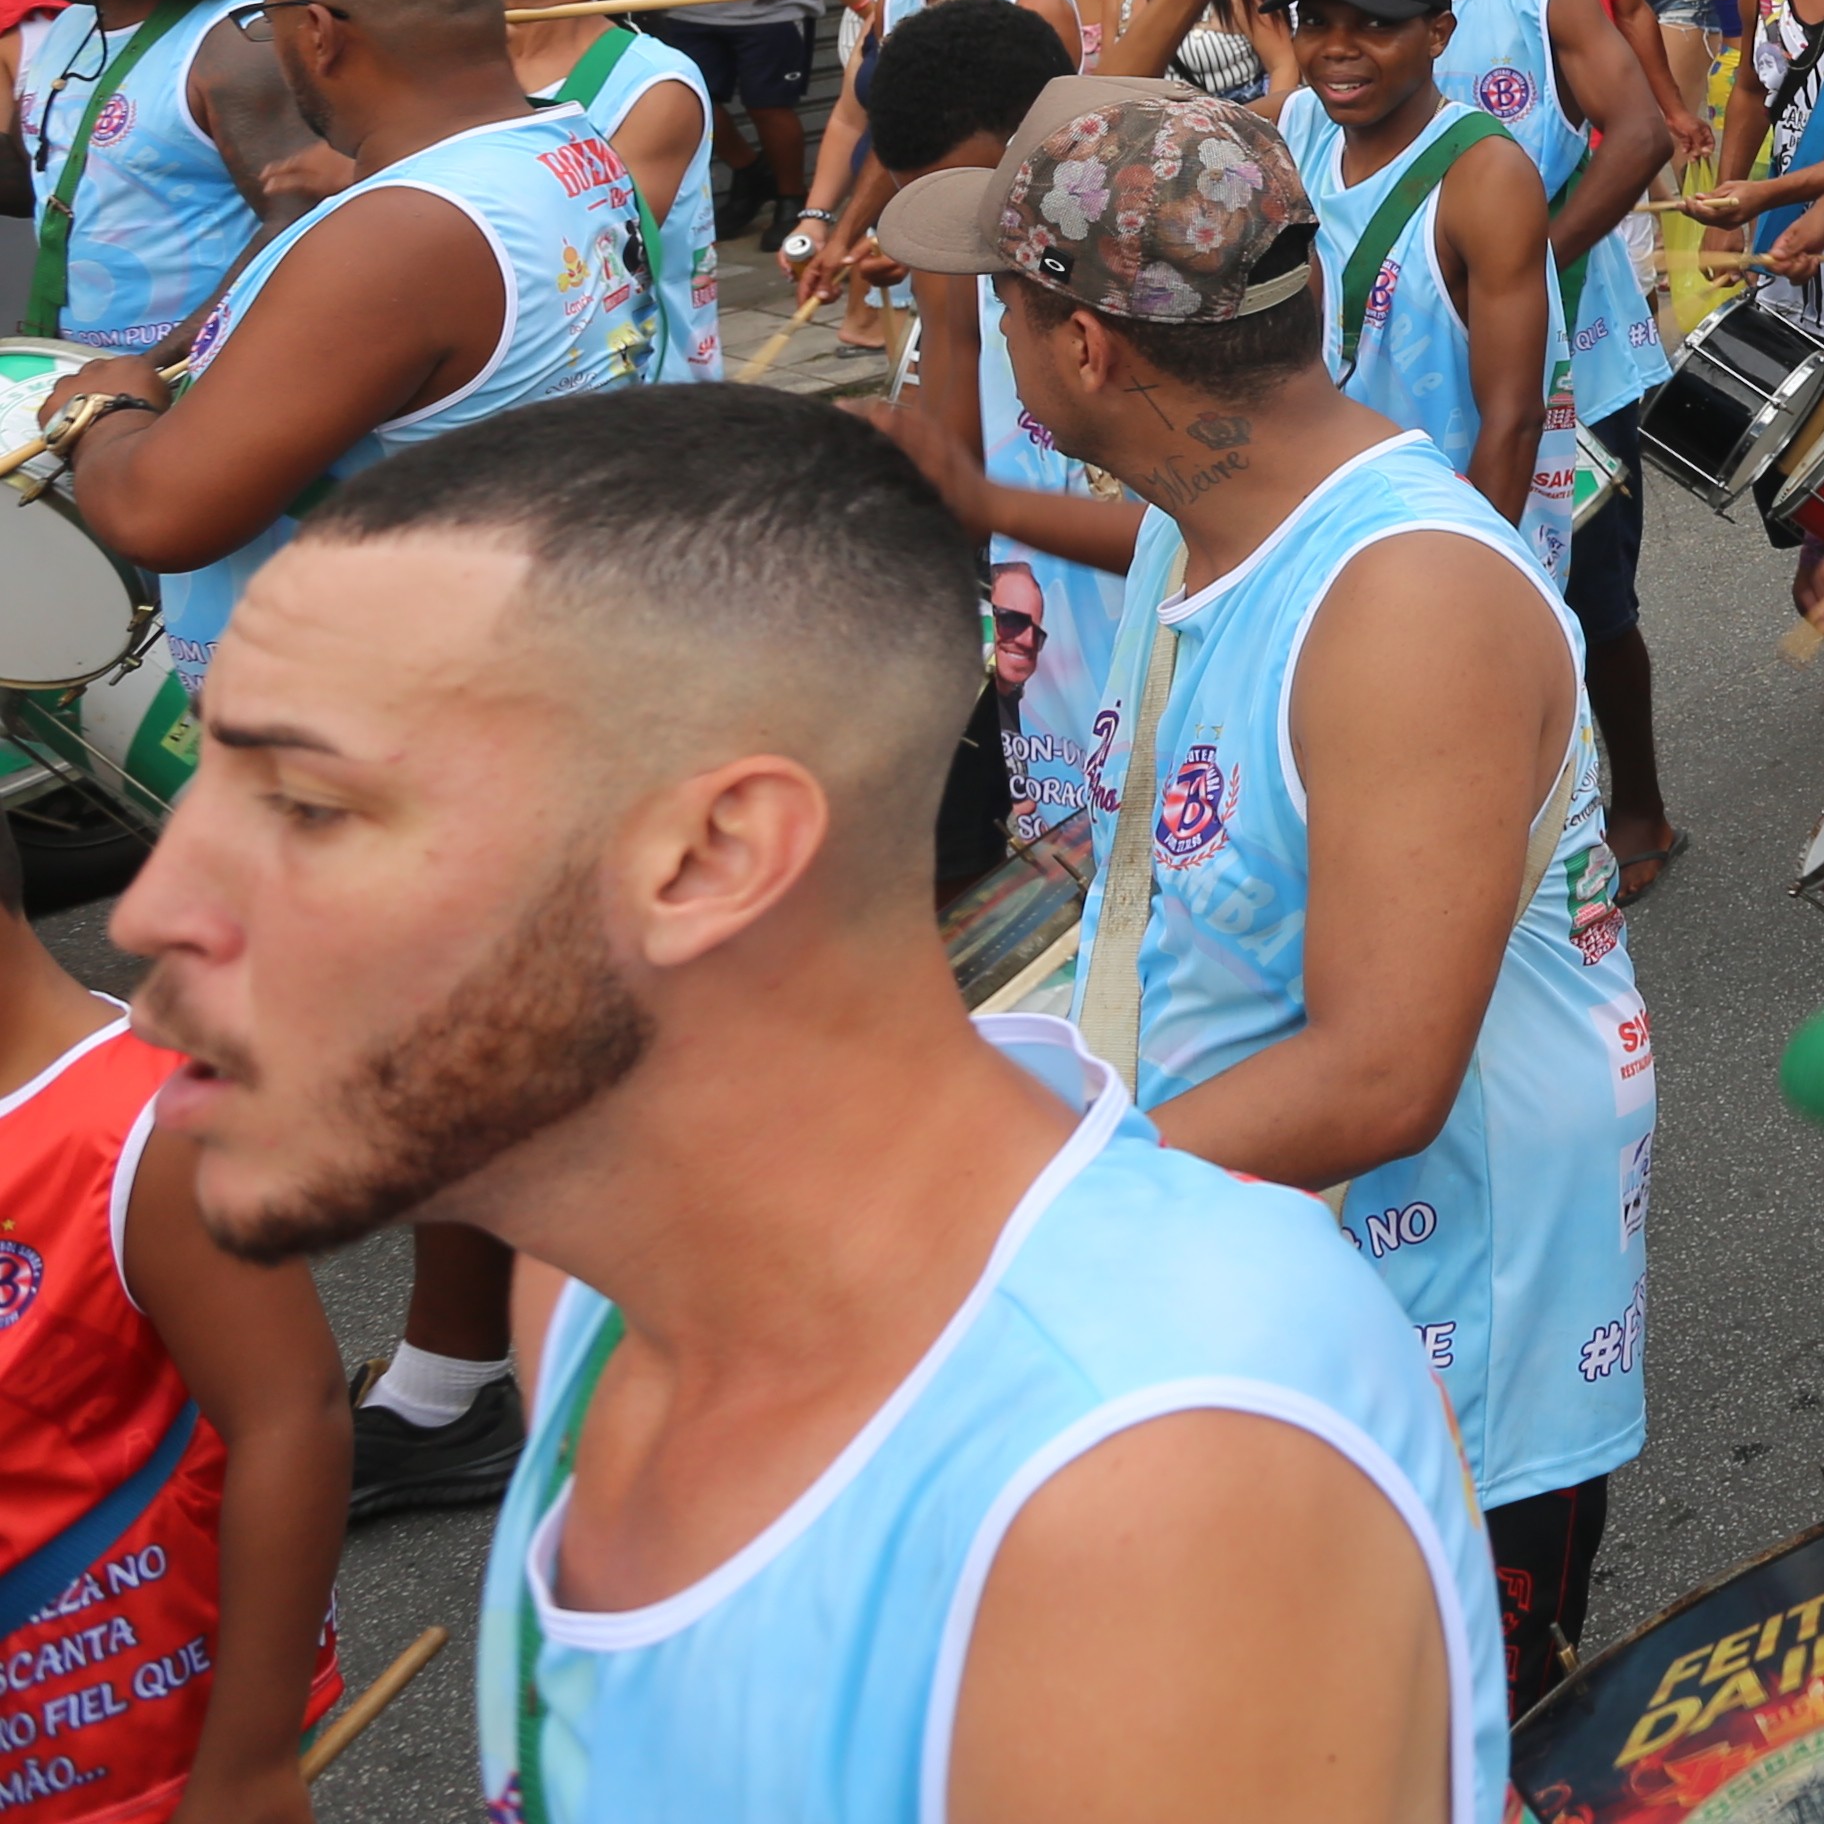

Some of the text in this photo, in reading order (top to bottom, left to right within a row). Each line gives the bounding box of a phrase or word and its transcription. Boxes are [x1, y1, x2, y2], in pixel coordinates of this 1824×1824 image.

[1367, 1201, 1437, 1258] NO
[106, 1545, 166, 1594] NO
[42, 1637, 211, 1737] FIEL QUE
[1613, 1664, 1768, 1770] DA
